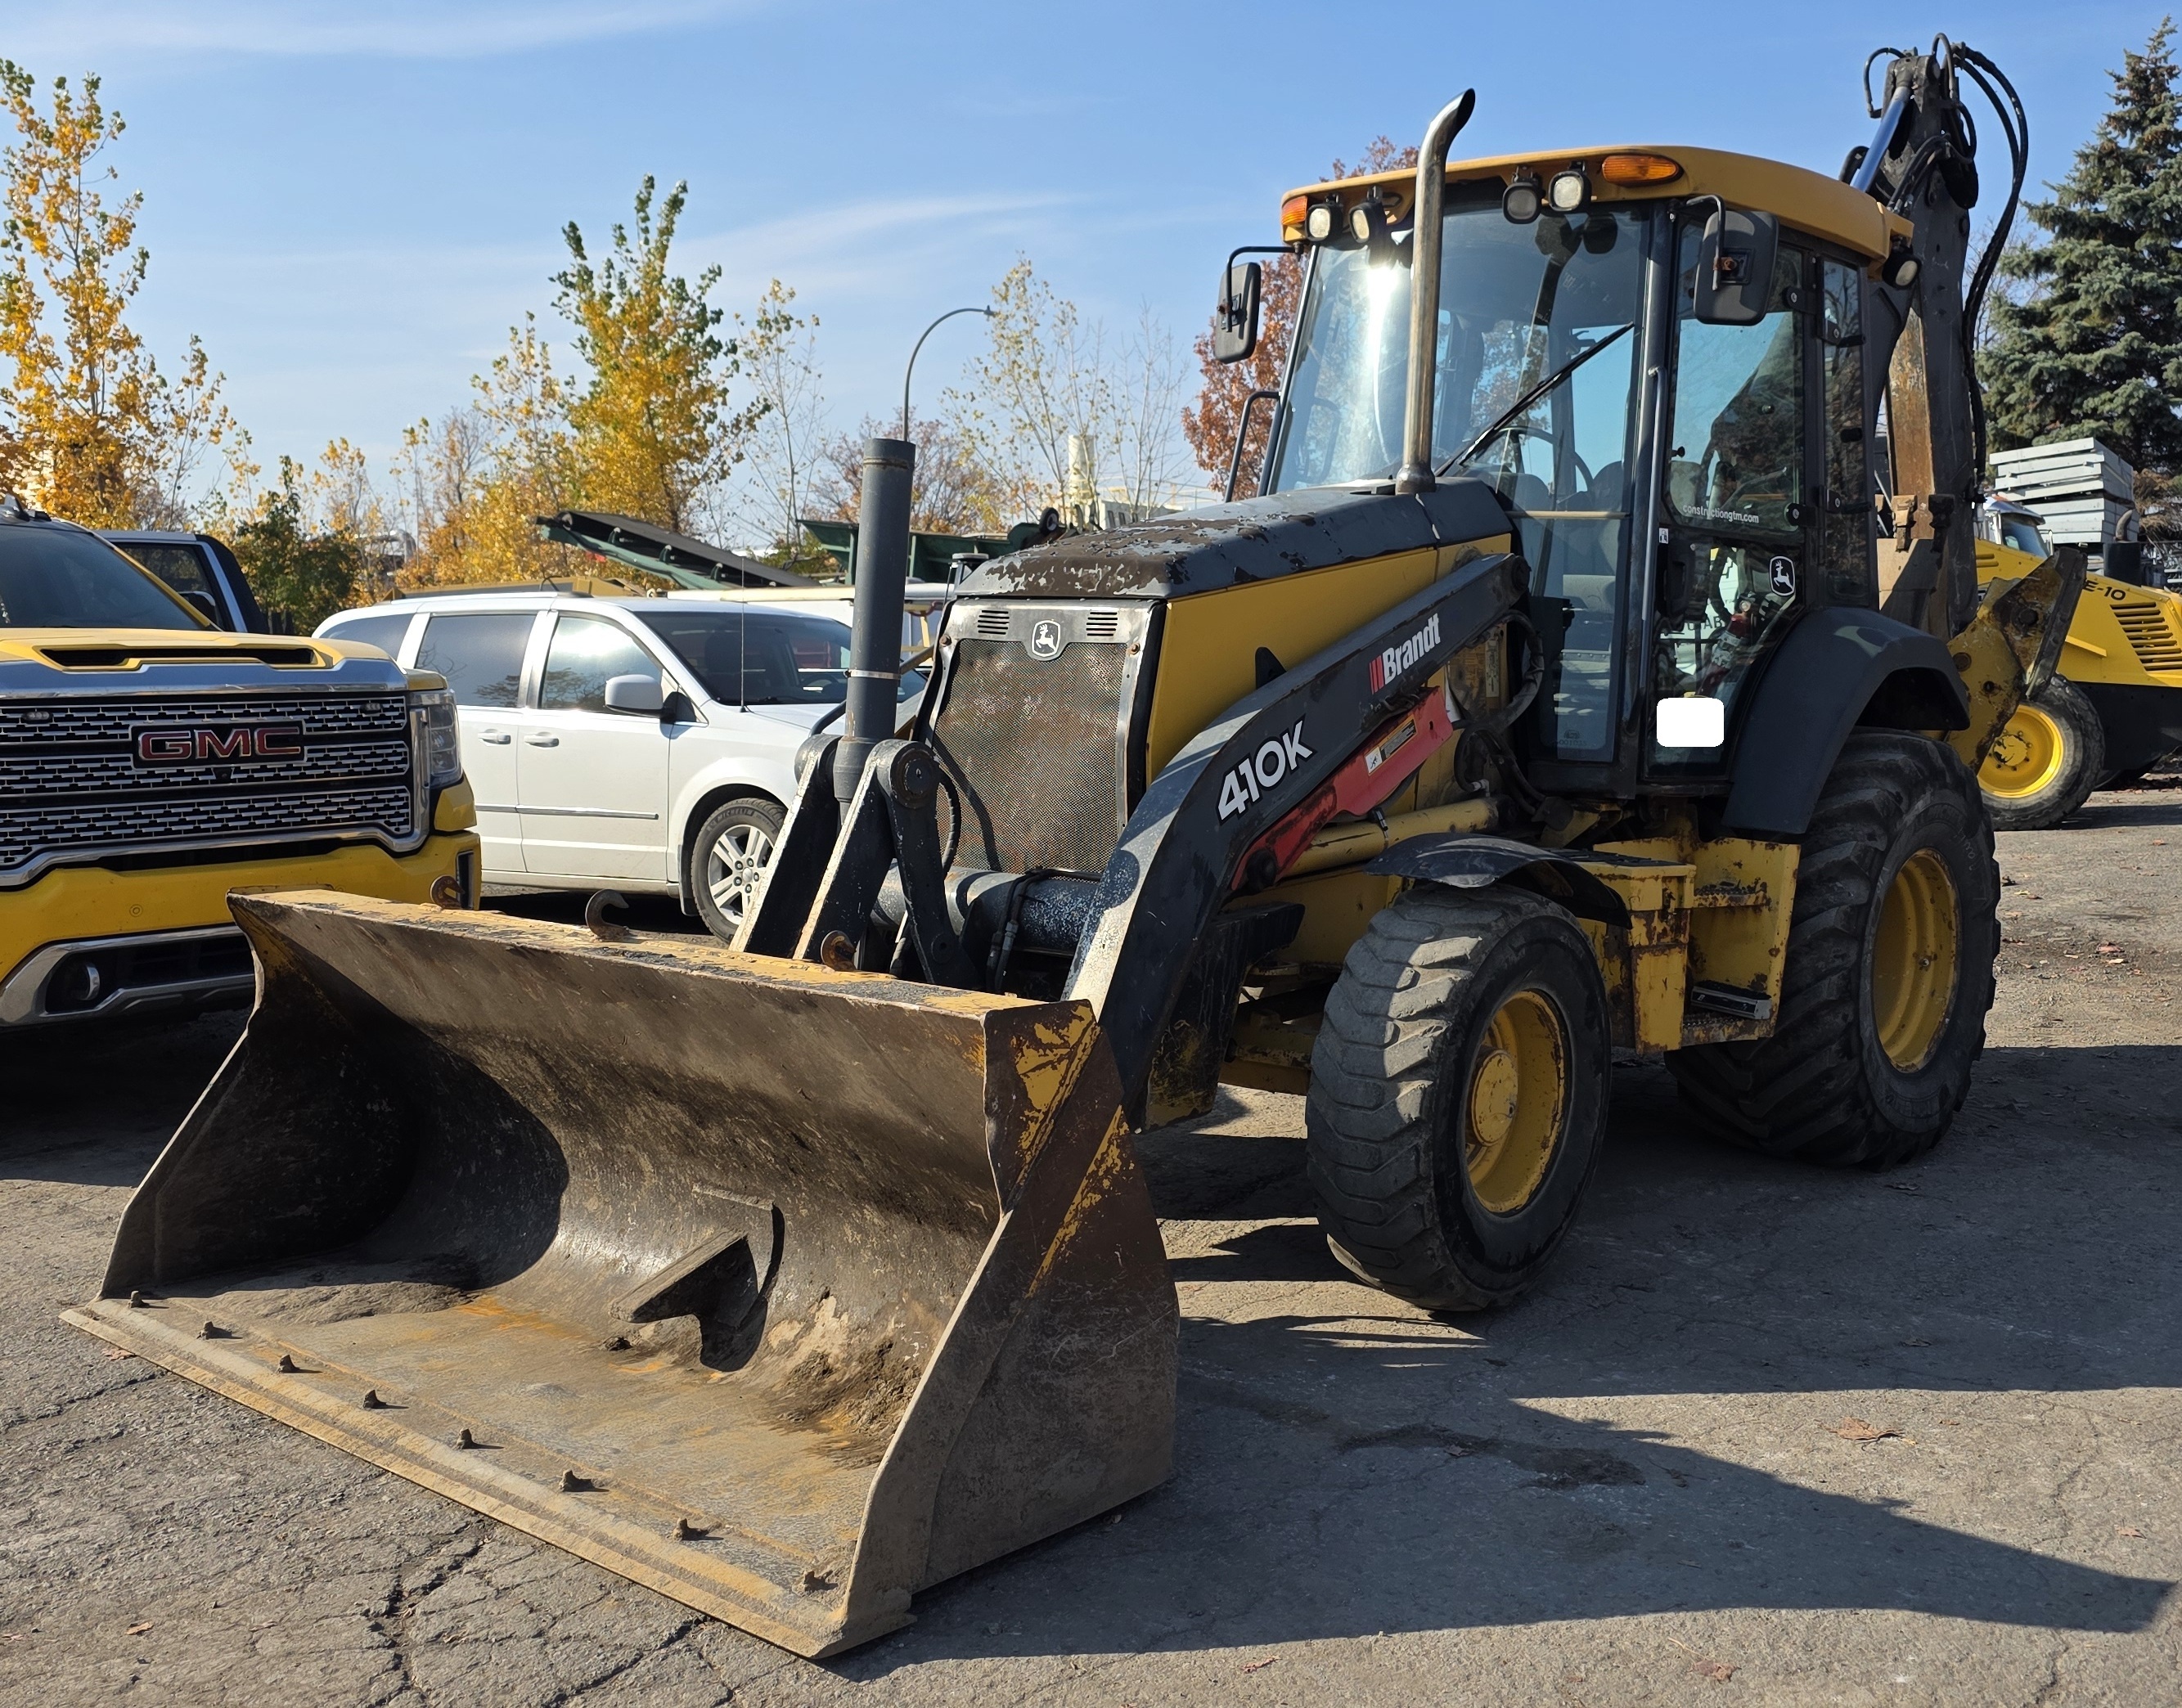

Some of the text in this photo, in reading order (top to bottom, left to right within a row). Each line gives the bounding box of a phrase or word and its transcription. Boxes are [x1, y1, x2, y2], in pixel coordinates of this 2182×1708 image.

[1382, 613, 1441, 685] Brandt
[138, 727, 301, 761] GMC
[1217, 720, 1313, 820] 410K
